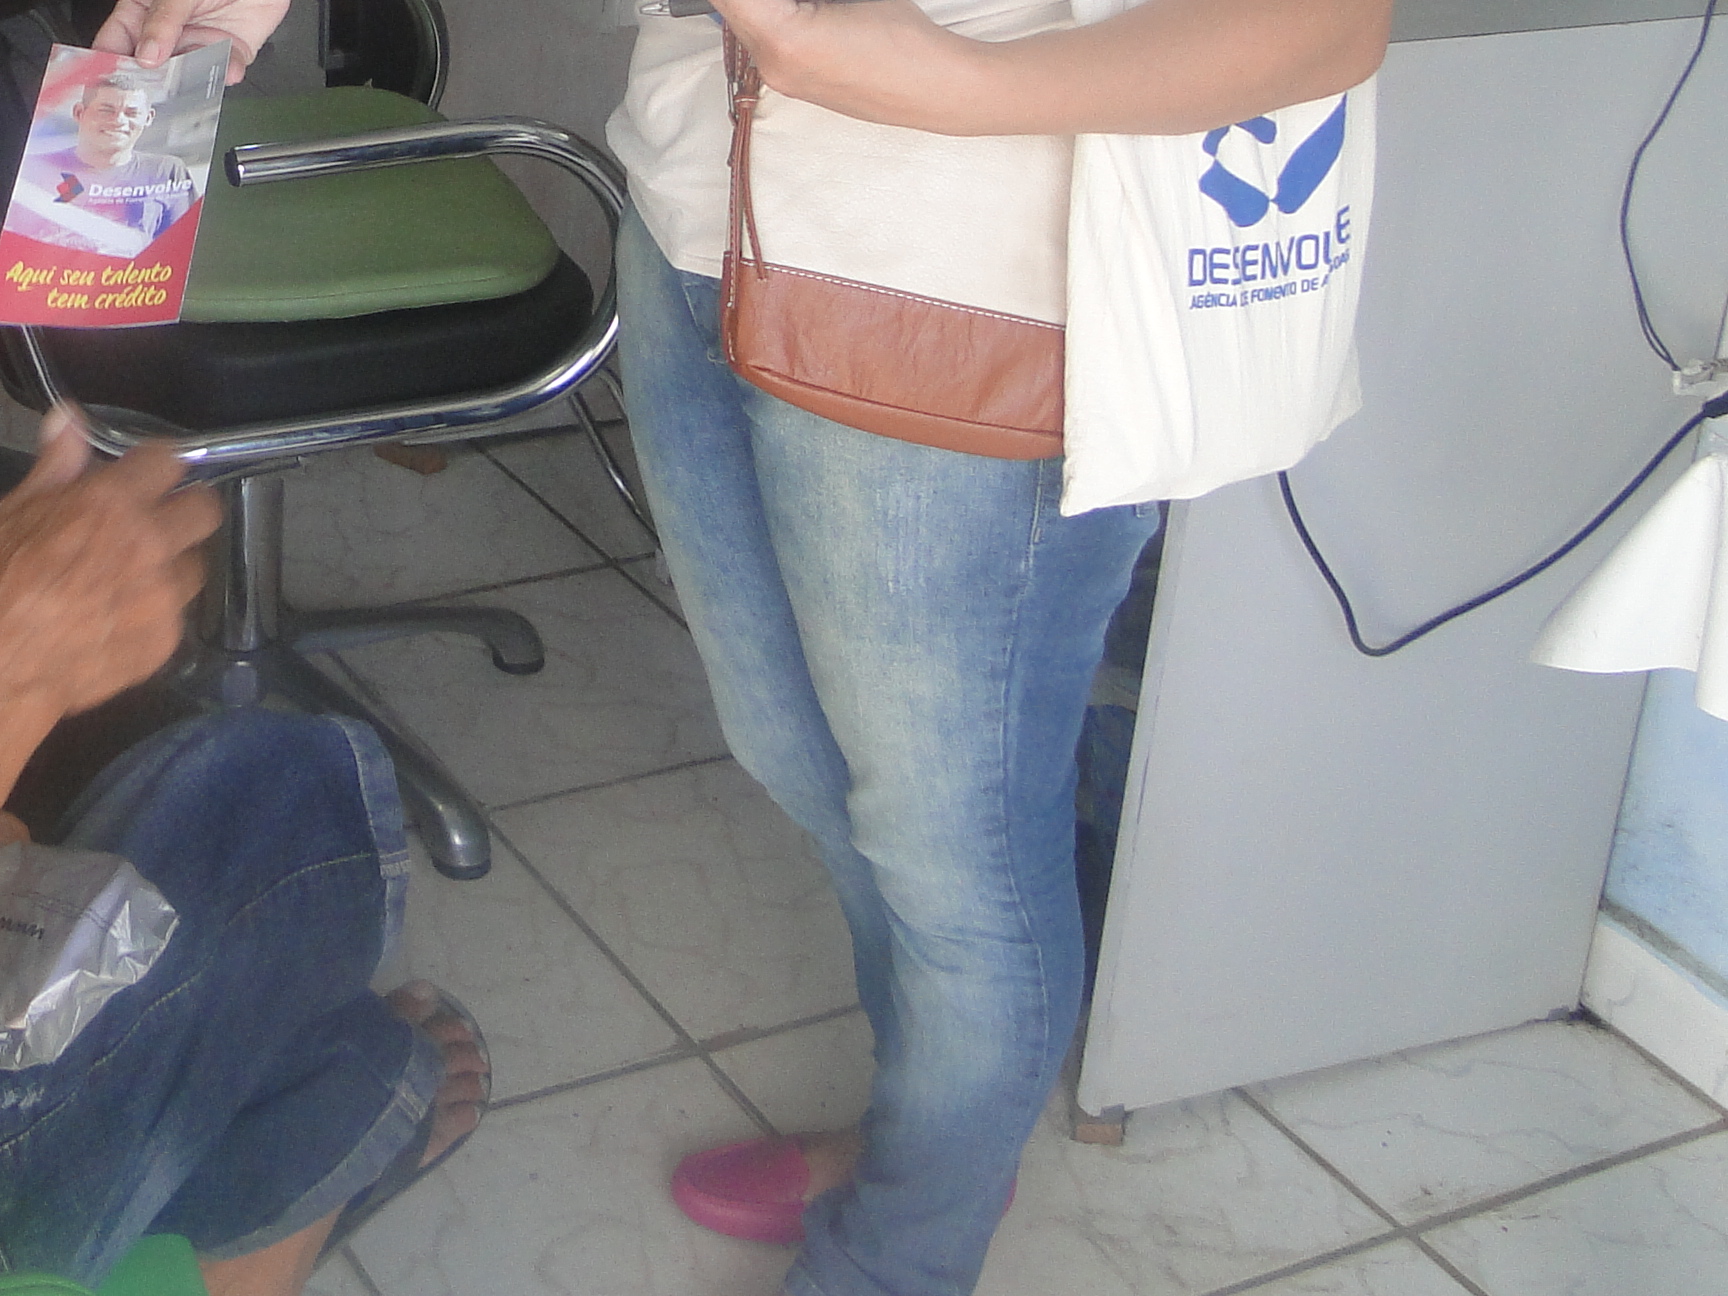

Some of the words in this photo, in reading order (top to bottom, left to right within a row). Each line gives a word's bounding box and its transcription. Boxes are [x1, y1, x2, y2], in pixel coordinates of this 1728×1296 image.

[88, 178, 193, 197] Desenvolve
[5, 260, 57, 292] Aqui
[59, 268, 95, 286] seu
[101, 260, 173, 286] talento
[47, 287, 90, 310] tem
[94, 283, 167, 310] crédito
[1189, 291, 1238, 310] AGÊNCIA
[1250, 280, 1297, 304] FOMENTO
[1301, 277, 1320, 293] DE
